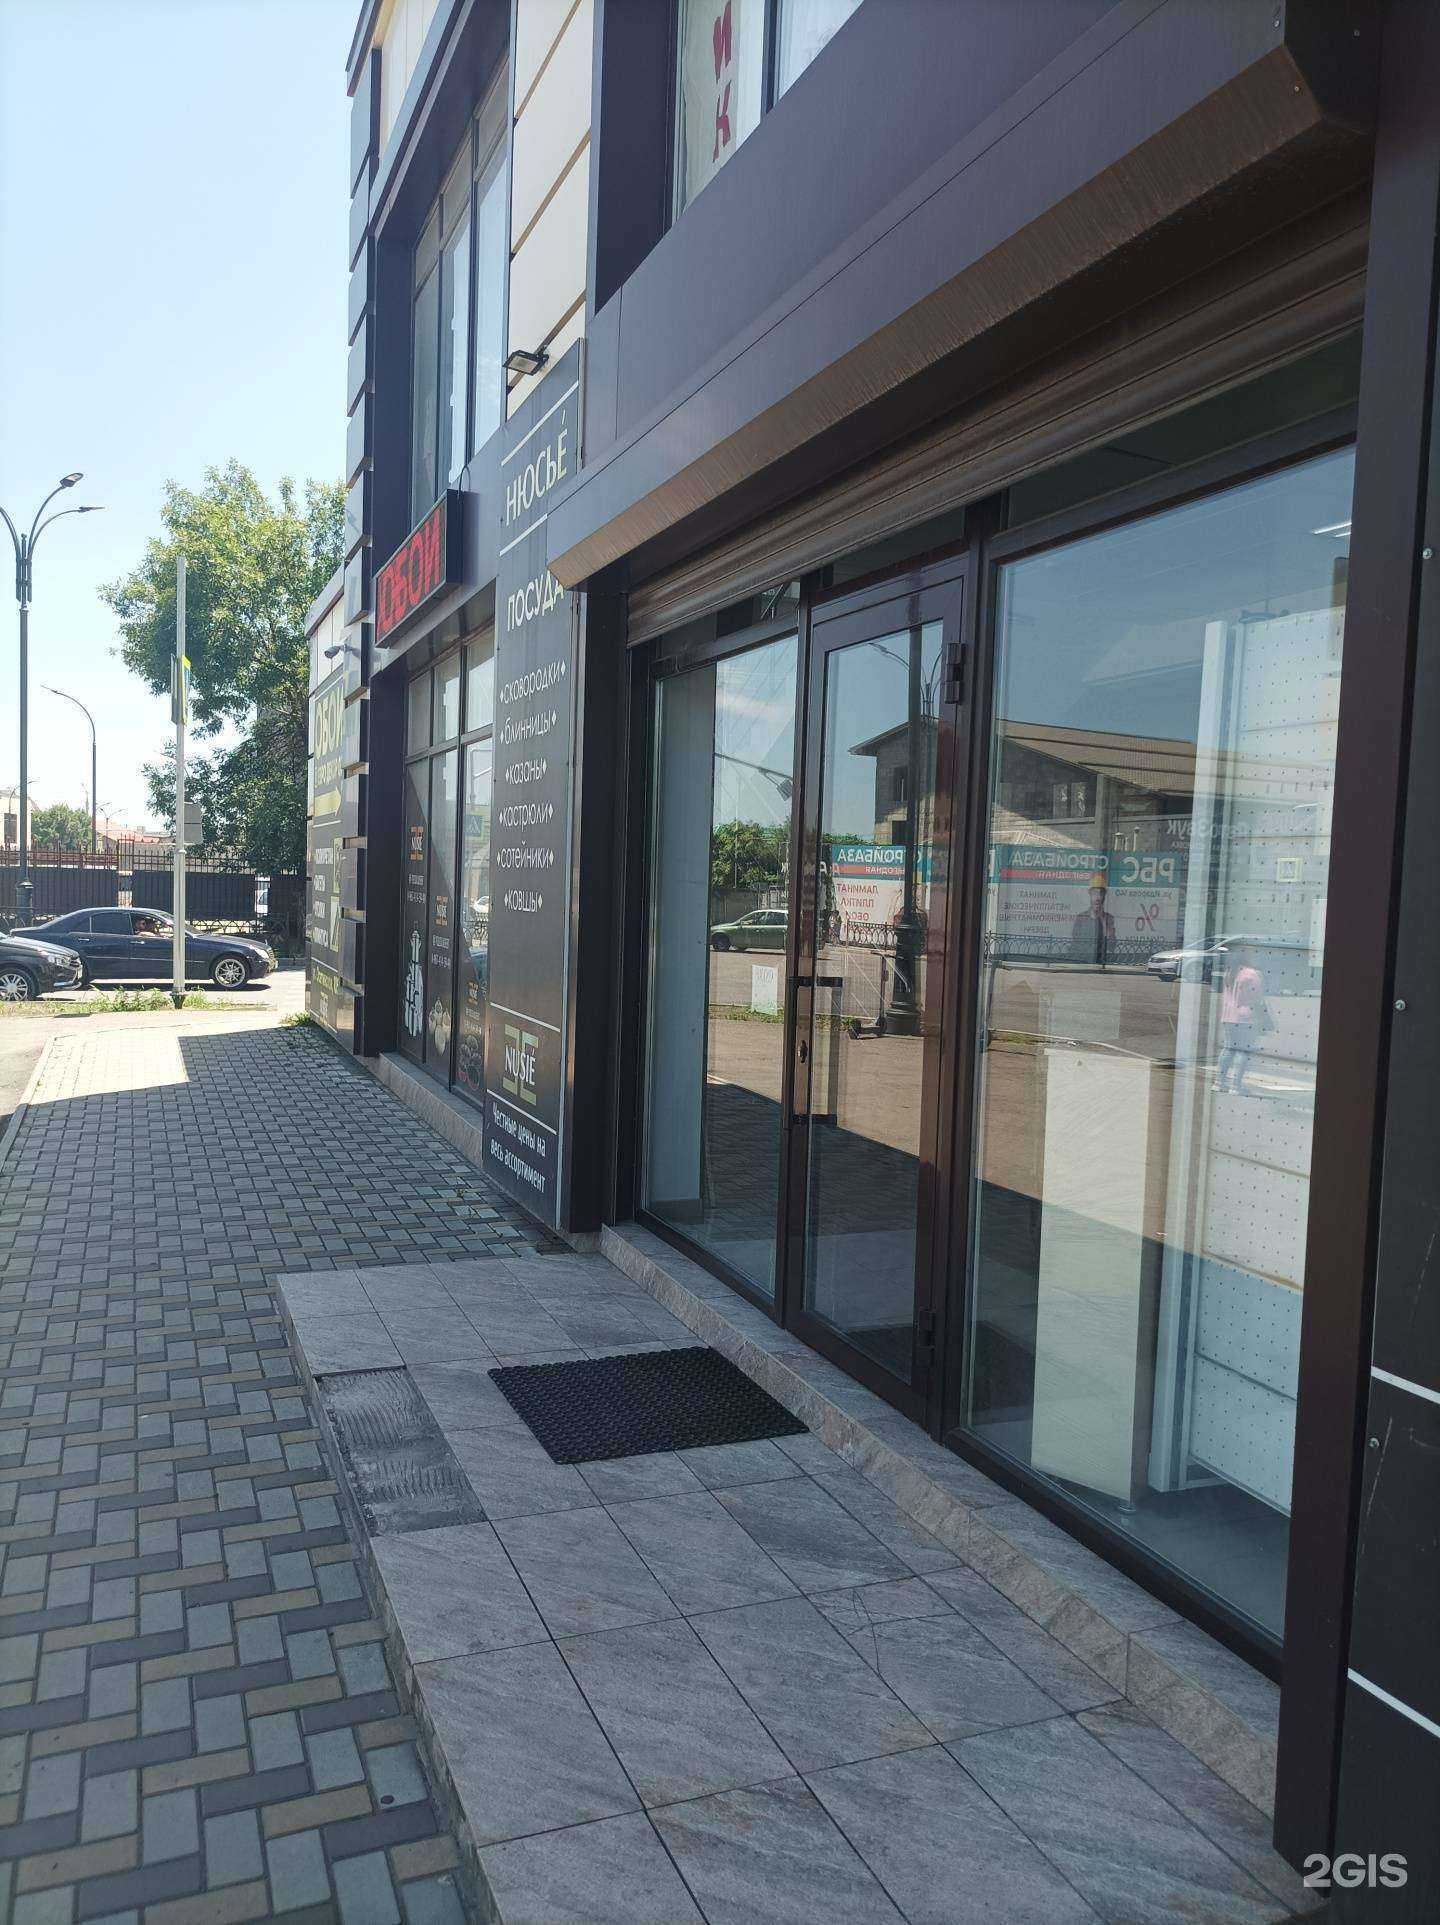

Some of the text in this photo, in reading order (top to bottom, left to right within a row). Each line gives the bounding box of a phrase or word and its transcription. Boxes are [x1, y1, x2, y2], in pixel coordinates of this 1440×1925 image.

[379, 507, 441, 634] ОБОИ
[503, 667, 561, 705] сковородки
[504, 717, 551, 745] блинницы
[508, 760, 544, 785] казаны
[500, 840, 551, 868] сотейники
[536, 1136, 547, 1158] на
[490, 1138, 546, 1194] весь ассортимент
